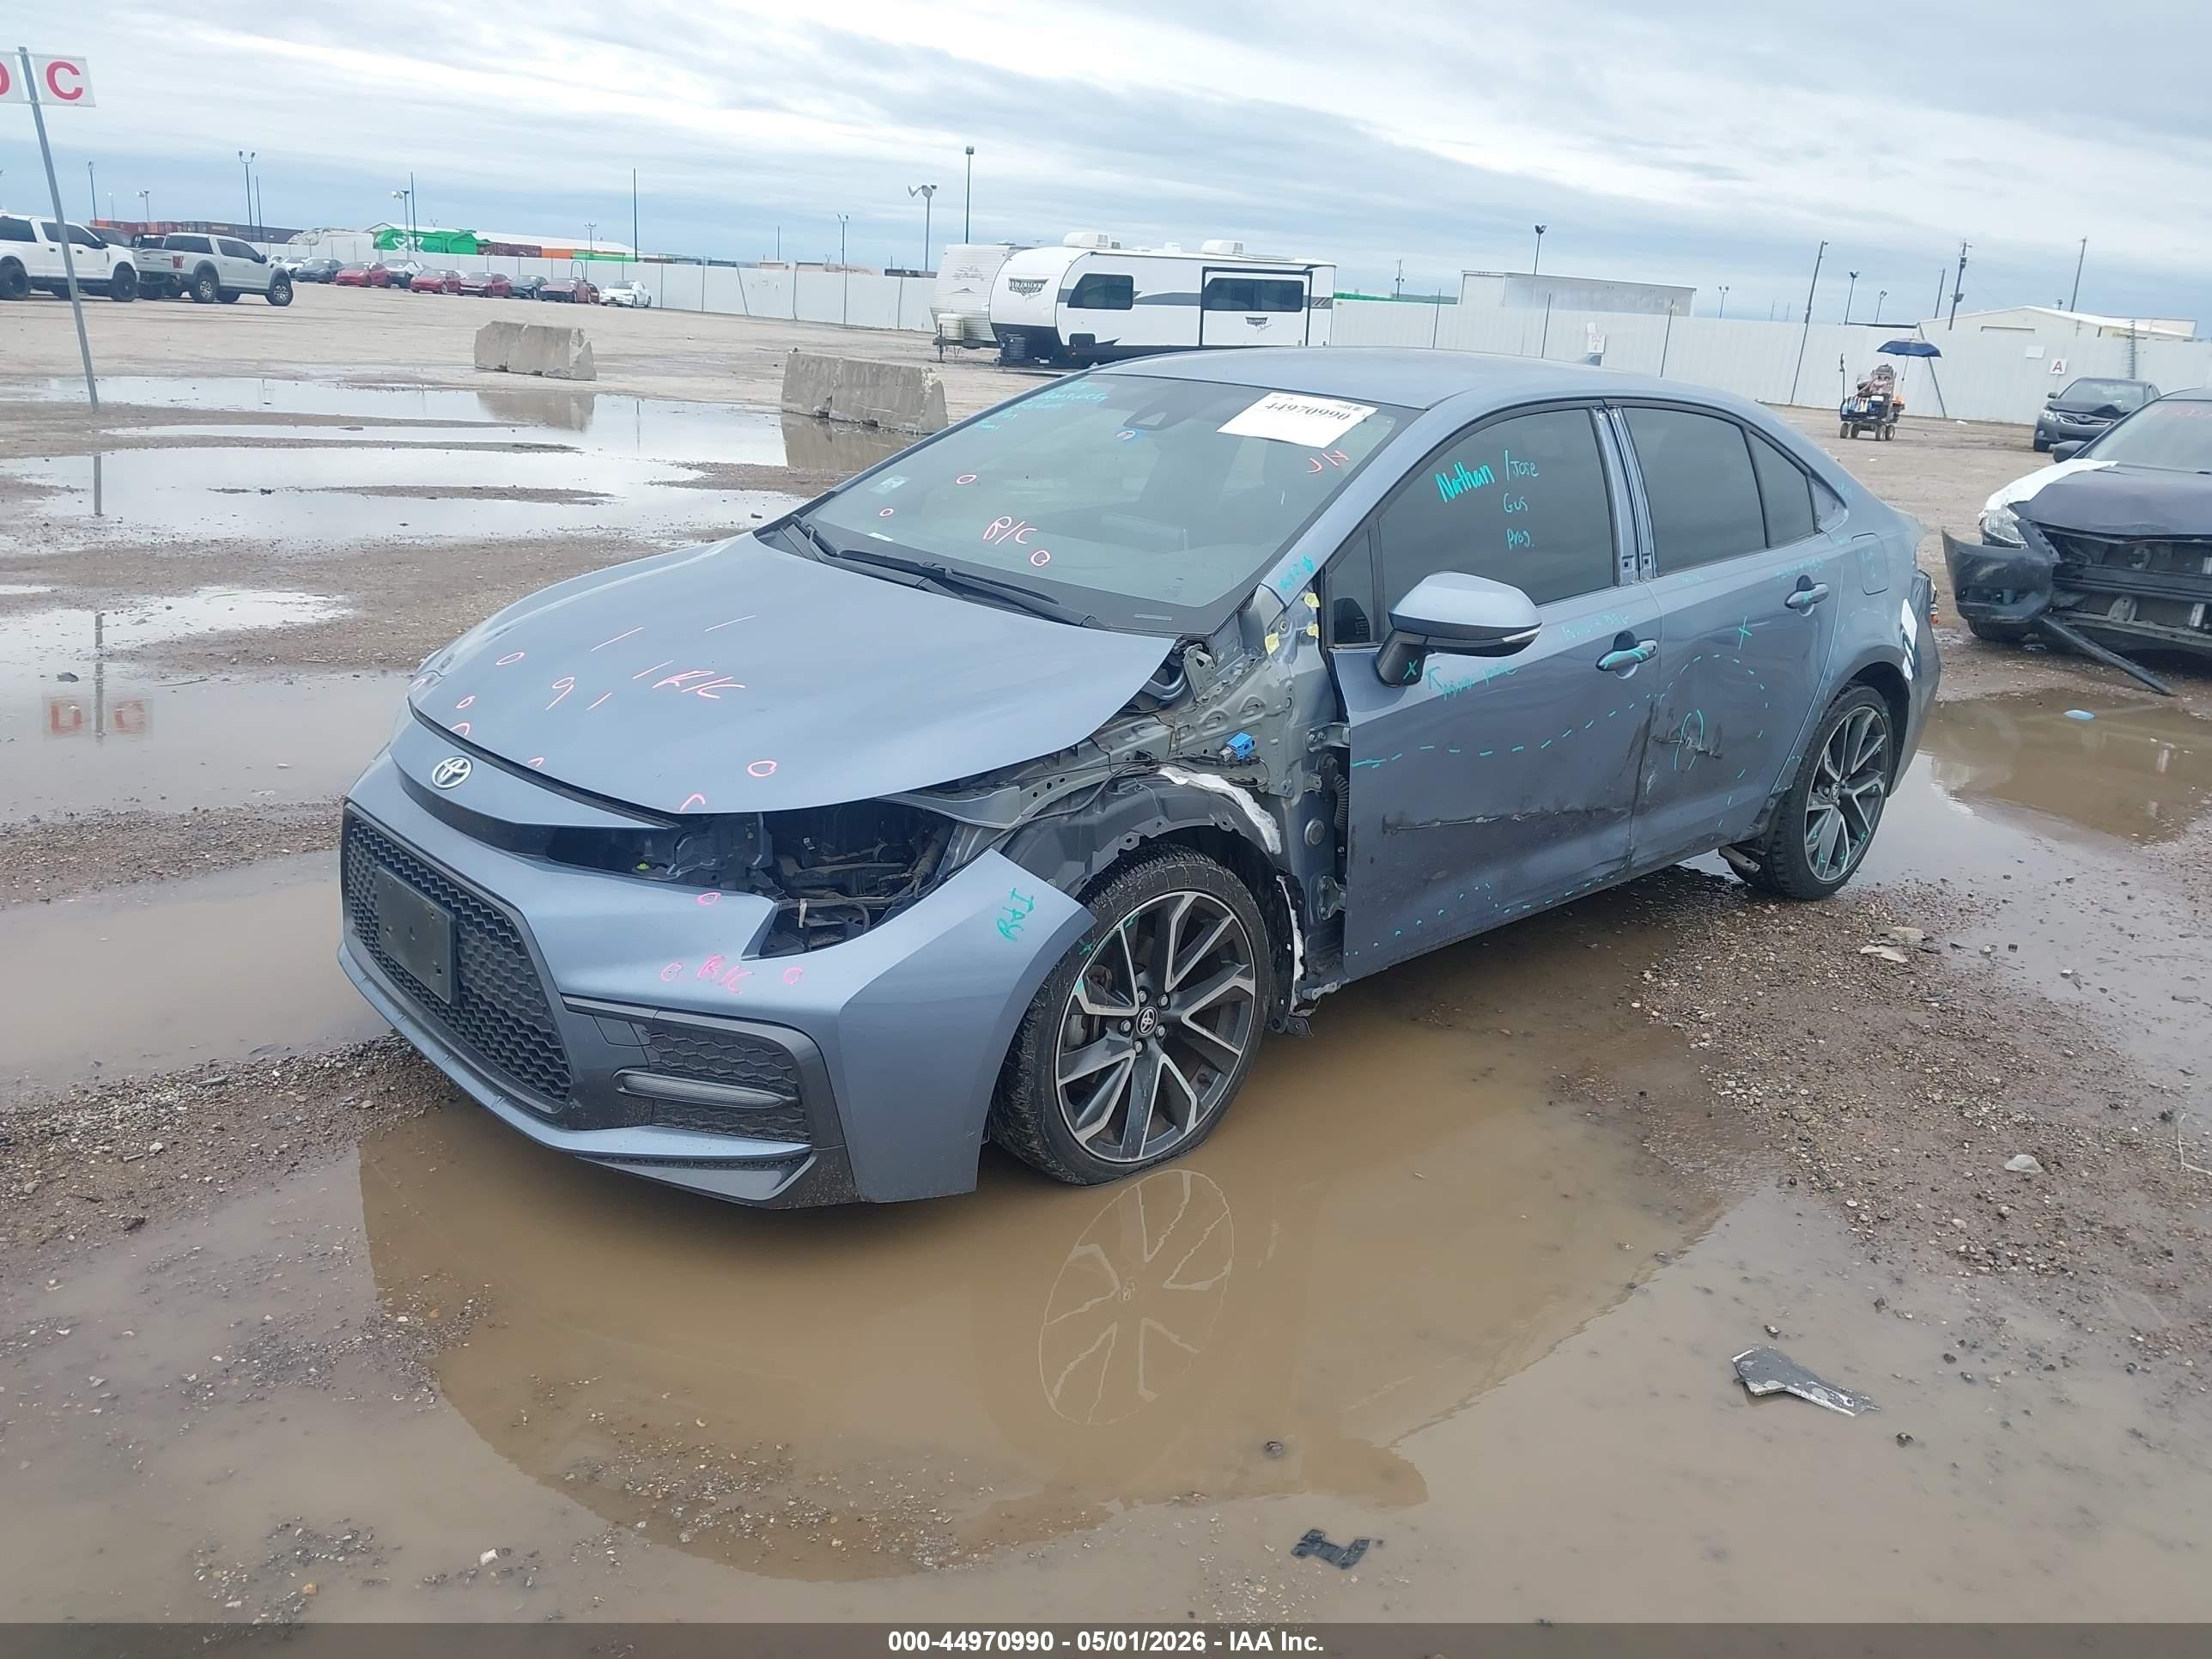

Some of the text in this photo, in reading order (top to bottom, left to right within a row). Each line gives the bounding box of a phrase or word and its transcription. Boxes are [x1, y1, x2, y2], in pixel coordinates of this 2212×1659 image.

[46, 61, 83, 100] C
[2052, 361, 2063, 373] A
[1264, 402, 1352, 422] 44970990
[1435, 461, 1495, 503] Nathan
[982, 516, 1038, 546] R/C
